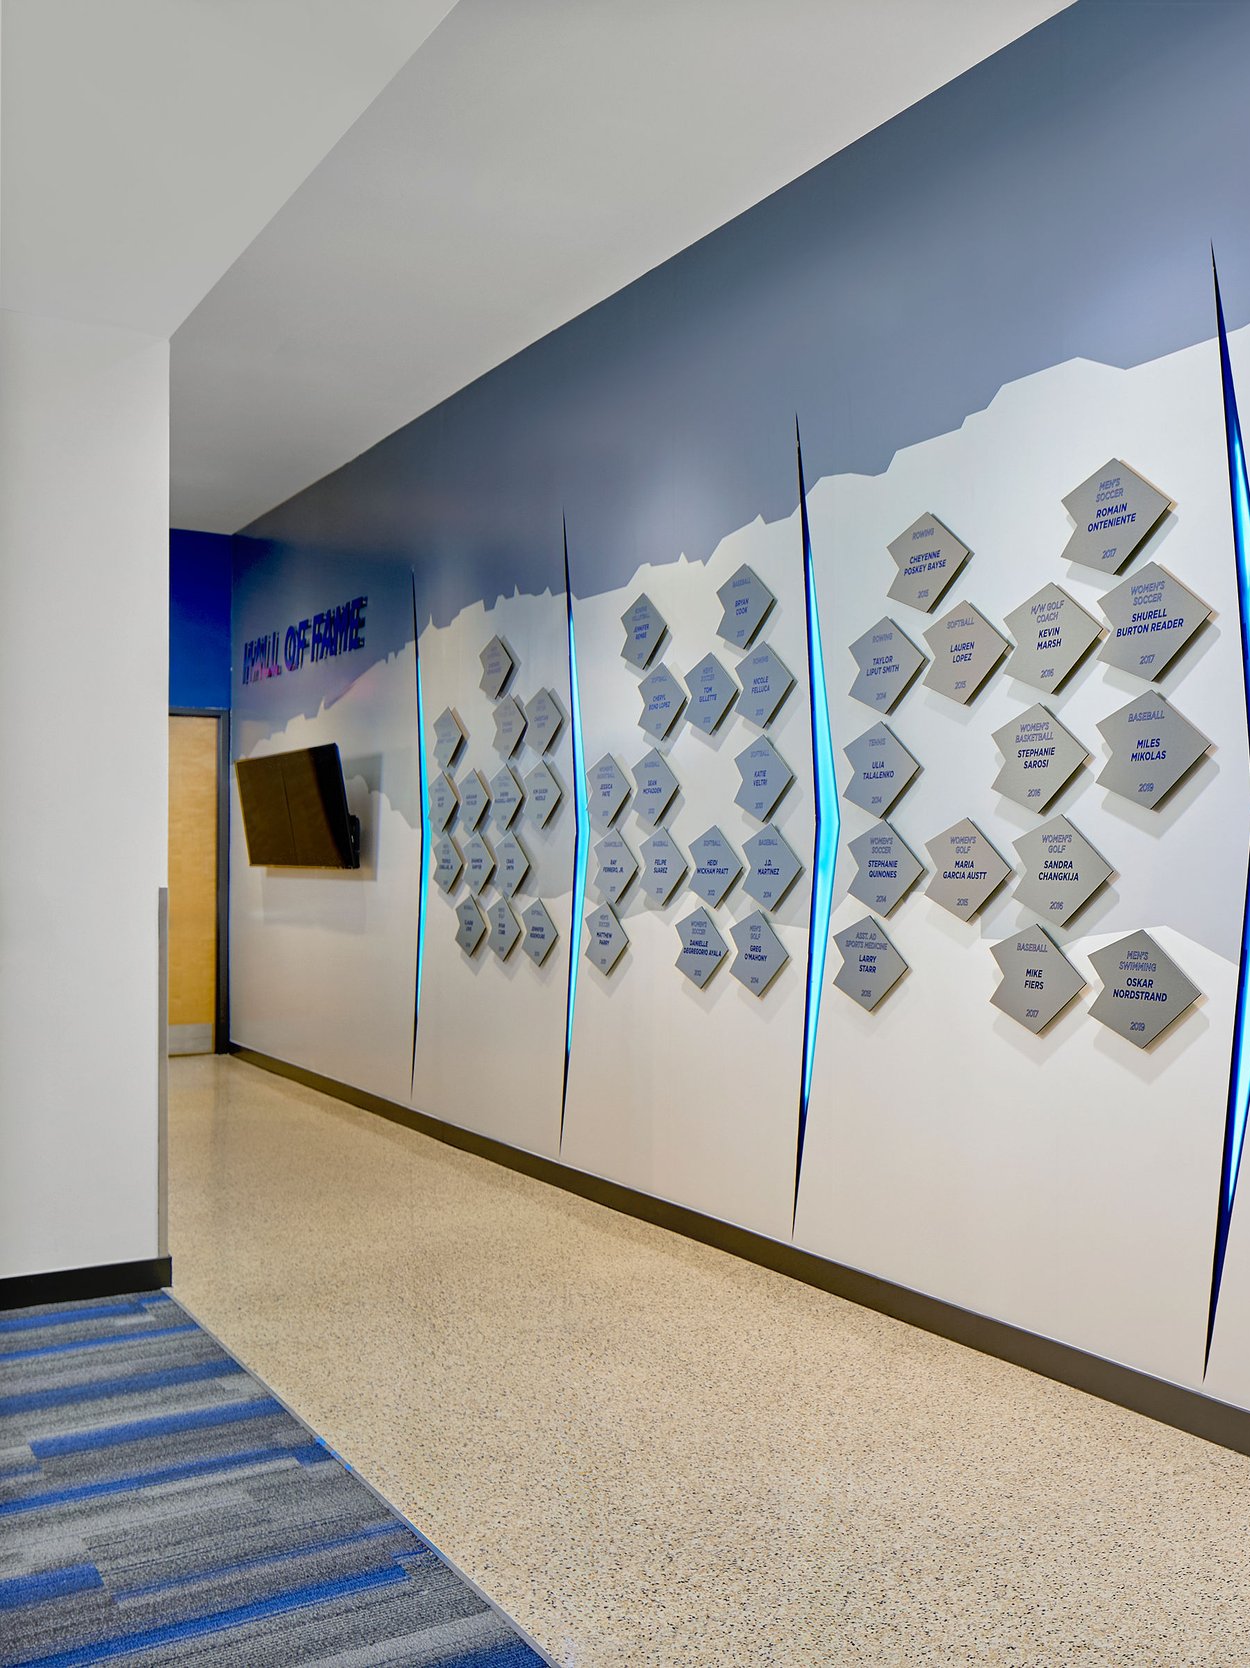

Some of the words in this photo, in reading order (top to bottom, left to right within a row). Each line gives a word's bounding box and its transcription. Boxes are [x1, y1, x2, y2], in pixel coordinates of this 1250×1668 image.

[1099, 478, 1120, 491] MEN'S
[1096, 488, 1123, 502] SOCCER
[1096, 503, 1127, 518] ROMAIN
[1087, 513, 1136, 532] ONTENIENTE
[909, 550, 941, 564] CHEYENNE
[1102, 548, 1116, 559] 2017
[904, 563, 926, 576] POSKEY
[927, 559, 946, 571] BAYSE
[1131, 581, 1165, 595] WOMEN'S
[1133, 593, 1162, 606] SOCCER
[1047, 600, 1064, 610] GOLF
[1036, 612, 1059, 623] COACH
[1132, 609, 1167, 622] SHURELL
[947, 617, 974, 630] SOFTBALL
[1116, 621, 1149, 637] BURTON
[1150, 618, 1184, 632] READER
[285, 619, 312, 671] OF
[311, 596, 368, 662] FAME
[1039, 627, 1060, 638] KEVIN
[950, 642, 975, 653] LAUREN
[1037, 639, 1061, 650] MARSH
[873, 656, 893, 665] TAYLOR
[953, 653, 972, 663] LOPEZ
[1139, 654, 1155, 665] 2017
[866, 667, 882, 677] LIPUT
[882, 664, 899, 674] SMITH
[753, 676, 769, 685] NICOLE
[1128, 711, 1165, 722] BASEBALL
[1020, 722, 1049, 732] WOMEN'S
[1015, 732, 1053, 743] BASKETBALL
[1137, 738, 1160, 749] MILES
[1017, 747, 1055, 758] STEPHANIE
[1131, 751, 1166, 761] MIKOLAS
[1023, 760, 1049, 769] SAROSI
[863, 771, 894, 780] TALALENKO
[1138, 783, 1154, 792] 2019
[870, 837, 893, 845] WOMEN'S
[950, 836, 976, 845] WOMEN'S
[1042, 834, 1072, 844] WOMEN'S
[872, 846, 891, 854] SOCCER
[956, 846, 971, 854] GOLF
[1048, 845, 1066, 853] GOLF
[868, 860, 898, 868] STEPHANIE
[954, 860, 974, 868] MARIA
[1043, 860, 1073, 869] SANDRA
[869, 870, 897, 878] QUINONES
[943, 871, 965, 879] GARCIA
[967, 872, 987, 880] AUSTT
[1038, 872, 1079, 882] CHANGKIJA
[1017, 942, 1048, 953] BASEBALL
[859, 955, 877, 963] LARRY
[1127, 950, 1149, 960] MEN'S
[859, 965, 877, 974] STARR
[1119, 961, 1157, 972] SWIMMING
[1026, 969, 1043, 978] MIKE
[1024, 980, 1044, 990] FIERS
[1126, 978, 1154, 988] OSKAR
[1112, 989, 1167, 1002] NORDSTRAND
[1026, 1009, 1039, 1018] 2017
[1130, 1022, 1145, 1031] 2019
